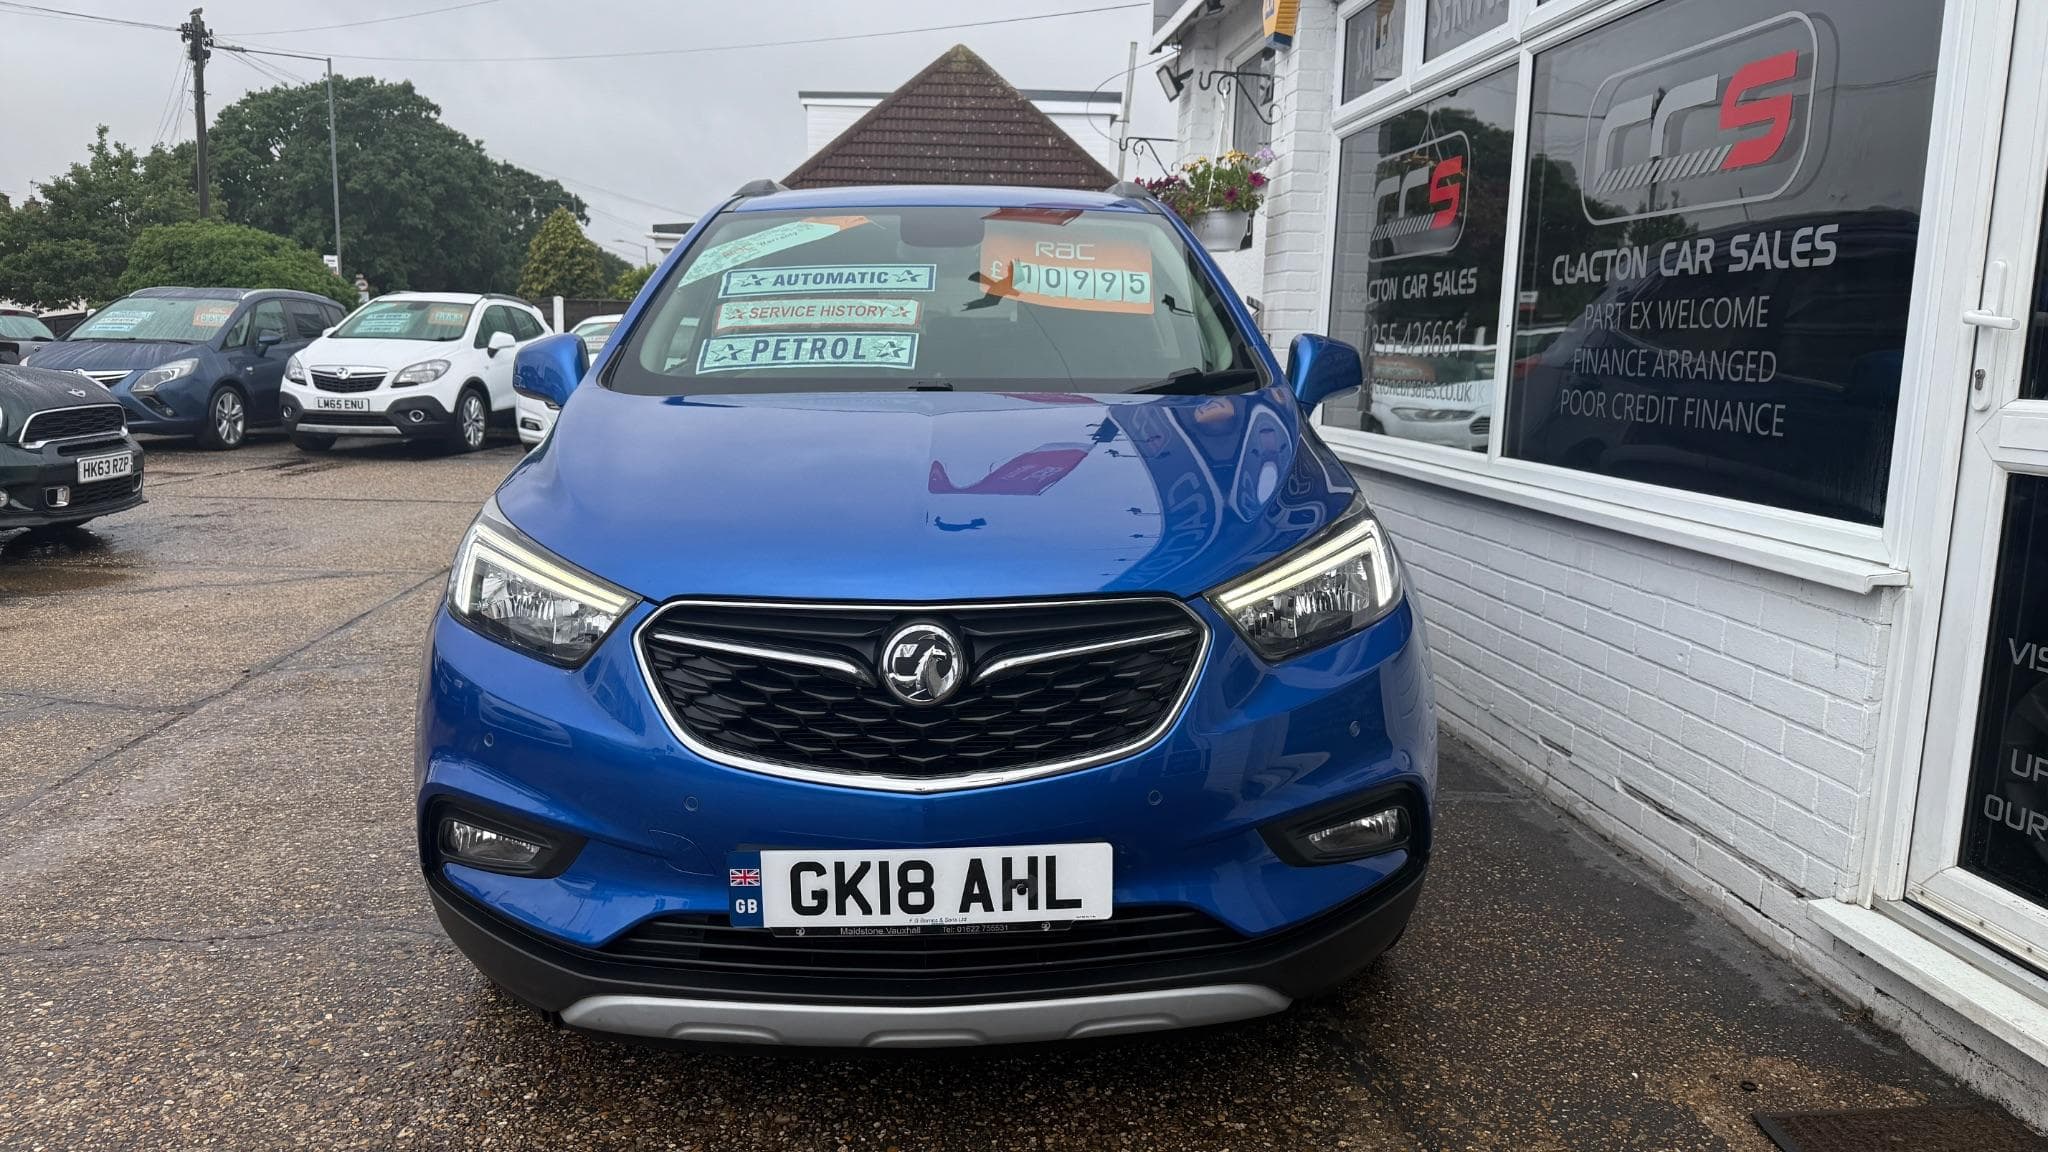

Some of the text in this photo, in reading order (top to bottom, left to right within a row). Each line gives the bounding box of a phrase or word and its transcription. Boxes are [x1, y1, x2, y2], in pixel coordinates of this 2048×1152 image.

[1552, 224, 1839, 285] CLACTON CAR SALES
[772, 271, 889, 287] AUTOMATIC
[1402, 273, 1429, 299] CAR
[1433, 267, 1478, 298] SALES
[749, 304, 888, 319] SERVICE HISTORY
[1584, 296, 1770, 330] PART EX WELCOME
[750, 337, 867, 362] PETROL
[1572, 348, 1777, 383] FINANCE ARRANGED
[317, 398, 364, 411] LM65 ENU
[1560, 389, 1786, 438] POOR CREDIT FINANCE
[83, 454, 130, 479] HK63 RZP
[789, 854, 1083, 917] GK18 AHL
[735, 898, 758, 914] GB
[840, 927, 884, 936] Maidstone
[885, 926, 921, 936] Vauxhall
